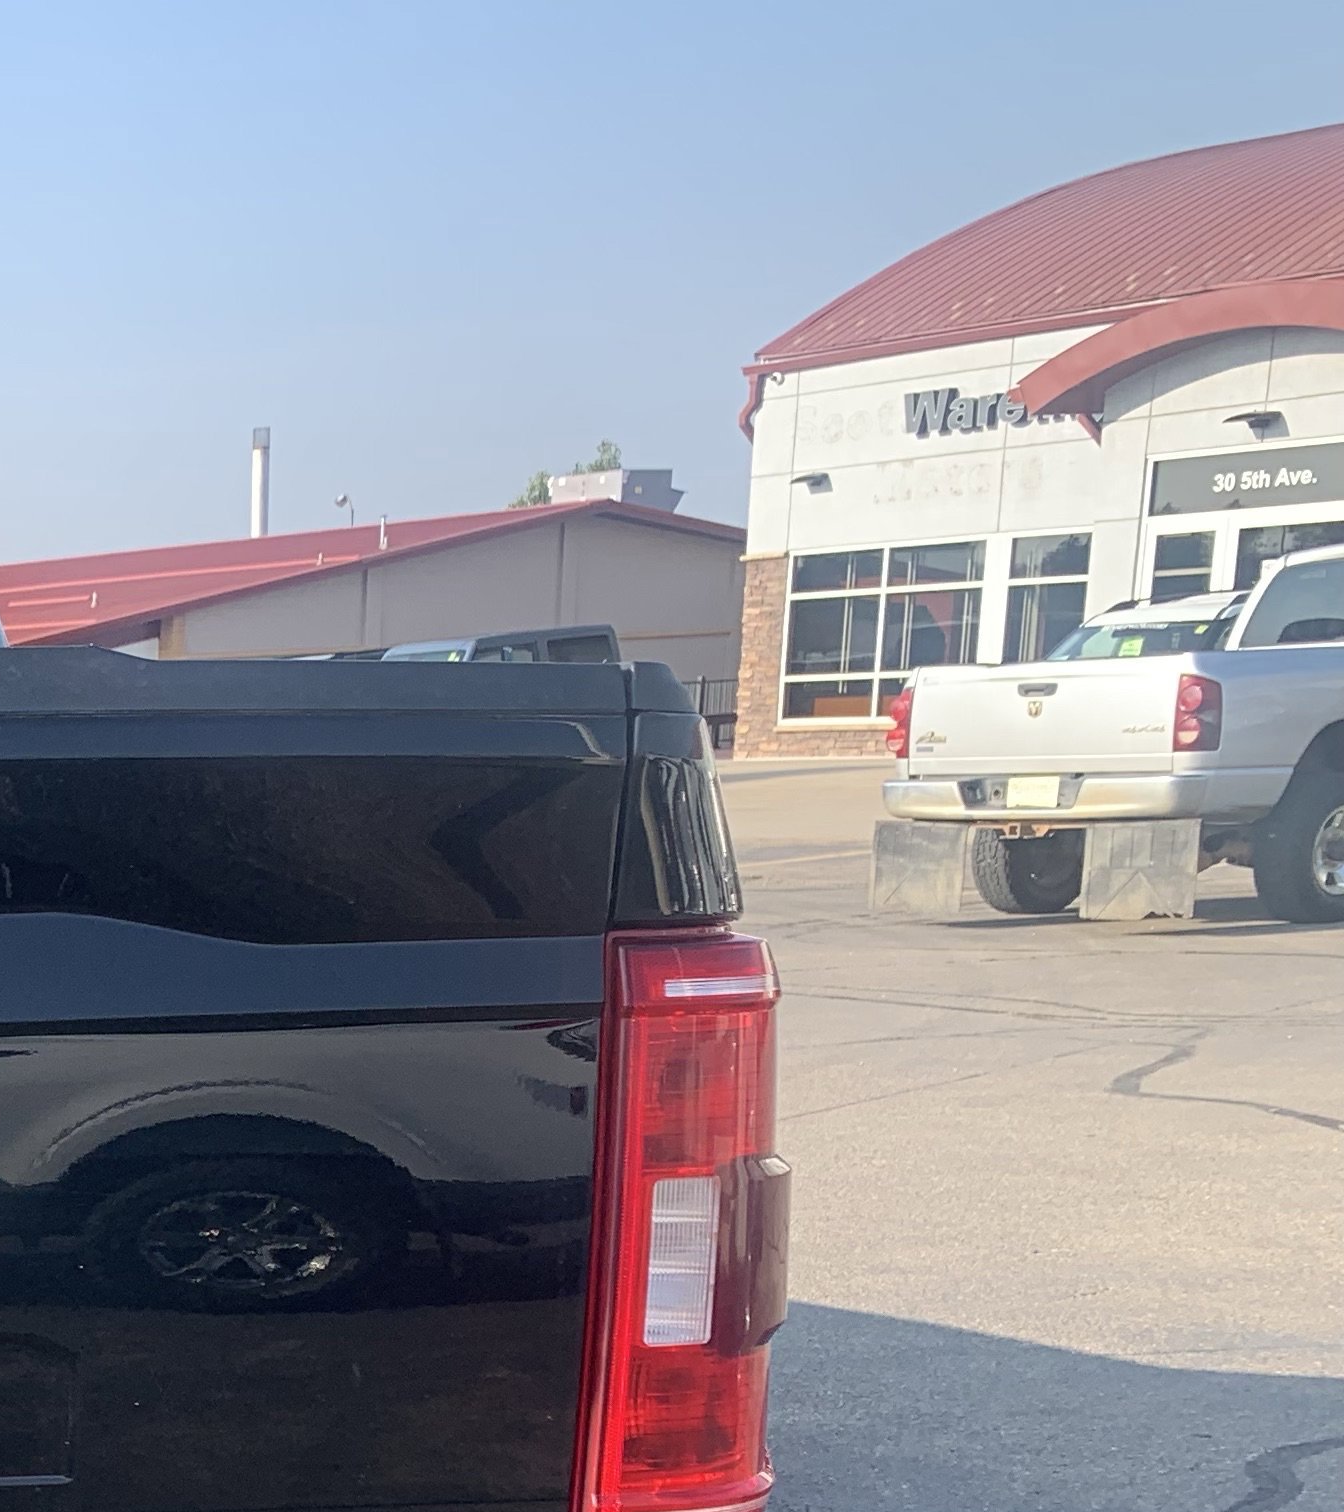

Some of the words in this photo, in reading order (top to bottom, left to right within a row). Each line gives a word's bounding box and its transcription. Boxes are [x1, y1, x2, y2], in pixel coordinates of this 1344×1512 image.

[904, 387, 1080, 438] Ware
[1212, 472, 1236, 493] 30
[1240, 469, 1271, 490] 5th
[1274, 467, 1318, 487] Ave.
